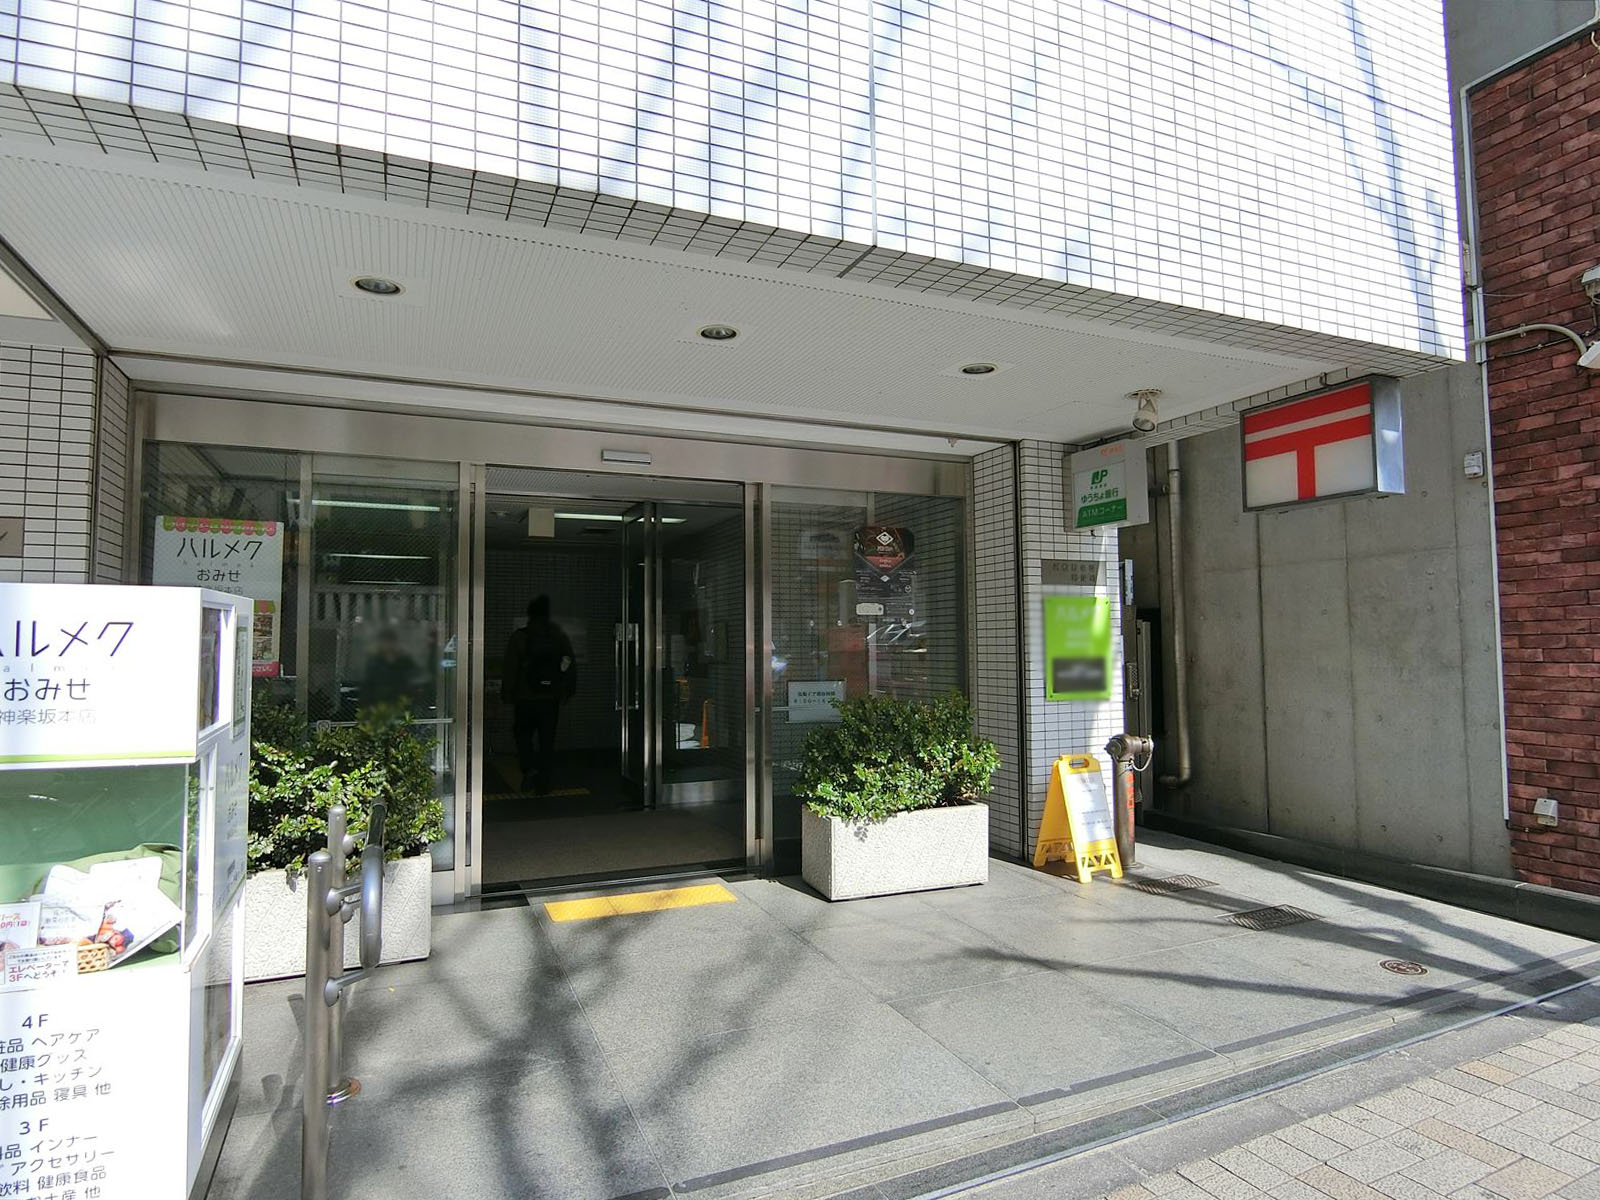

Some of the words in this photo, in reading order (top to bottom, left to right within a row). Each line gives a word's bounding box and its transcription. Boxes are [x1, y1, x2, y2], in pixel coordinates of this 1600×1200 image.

[177, 537, 263, 560] ハルメク
[197, 569, 241, 583] おみせ
[0, 620, 134, 657] ルメク
[4, 678, 91, 701] おみせ
[32, 1028, 100, 1047] ヘアケア
[54, 1085, 87, 1102] 寝具
[95, 1081, 112, 1096] 他
[30, 1135, 98, 1154] インナー
[37, 1165, 107, 1191] 健康食品
